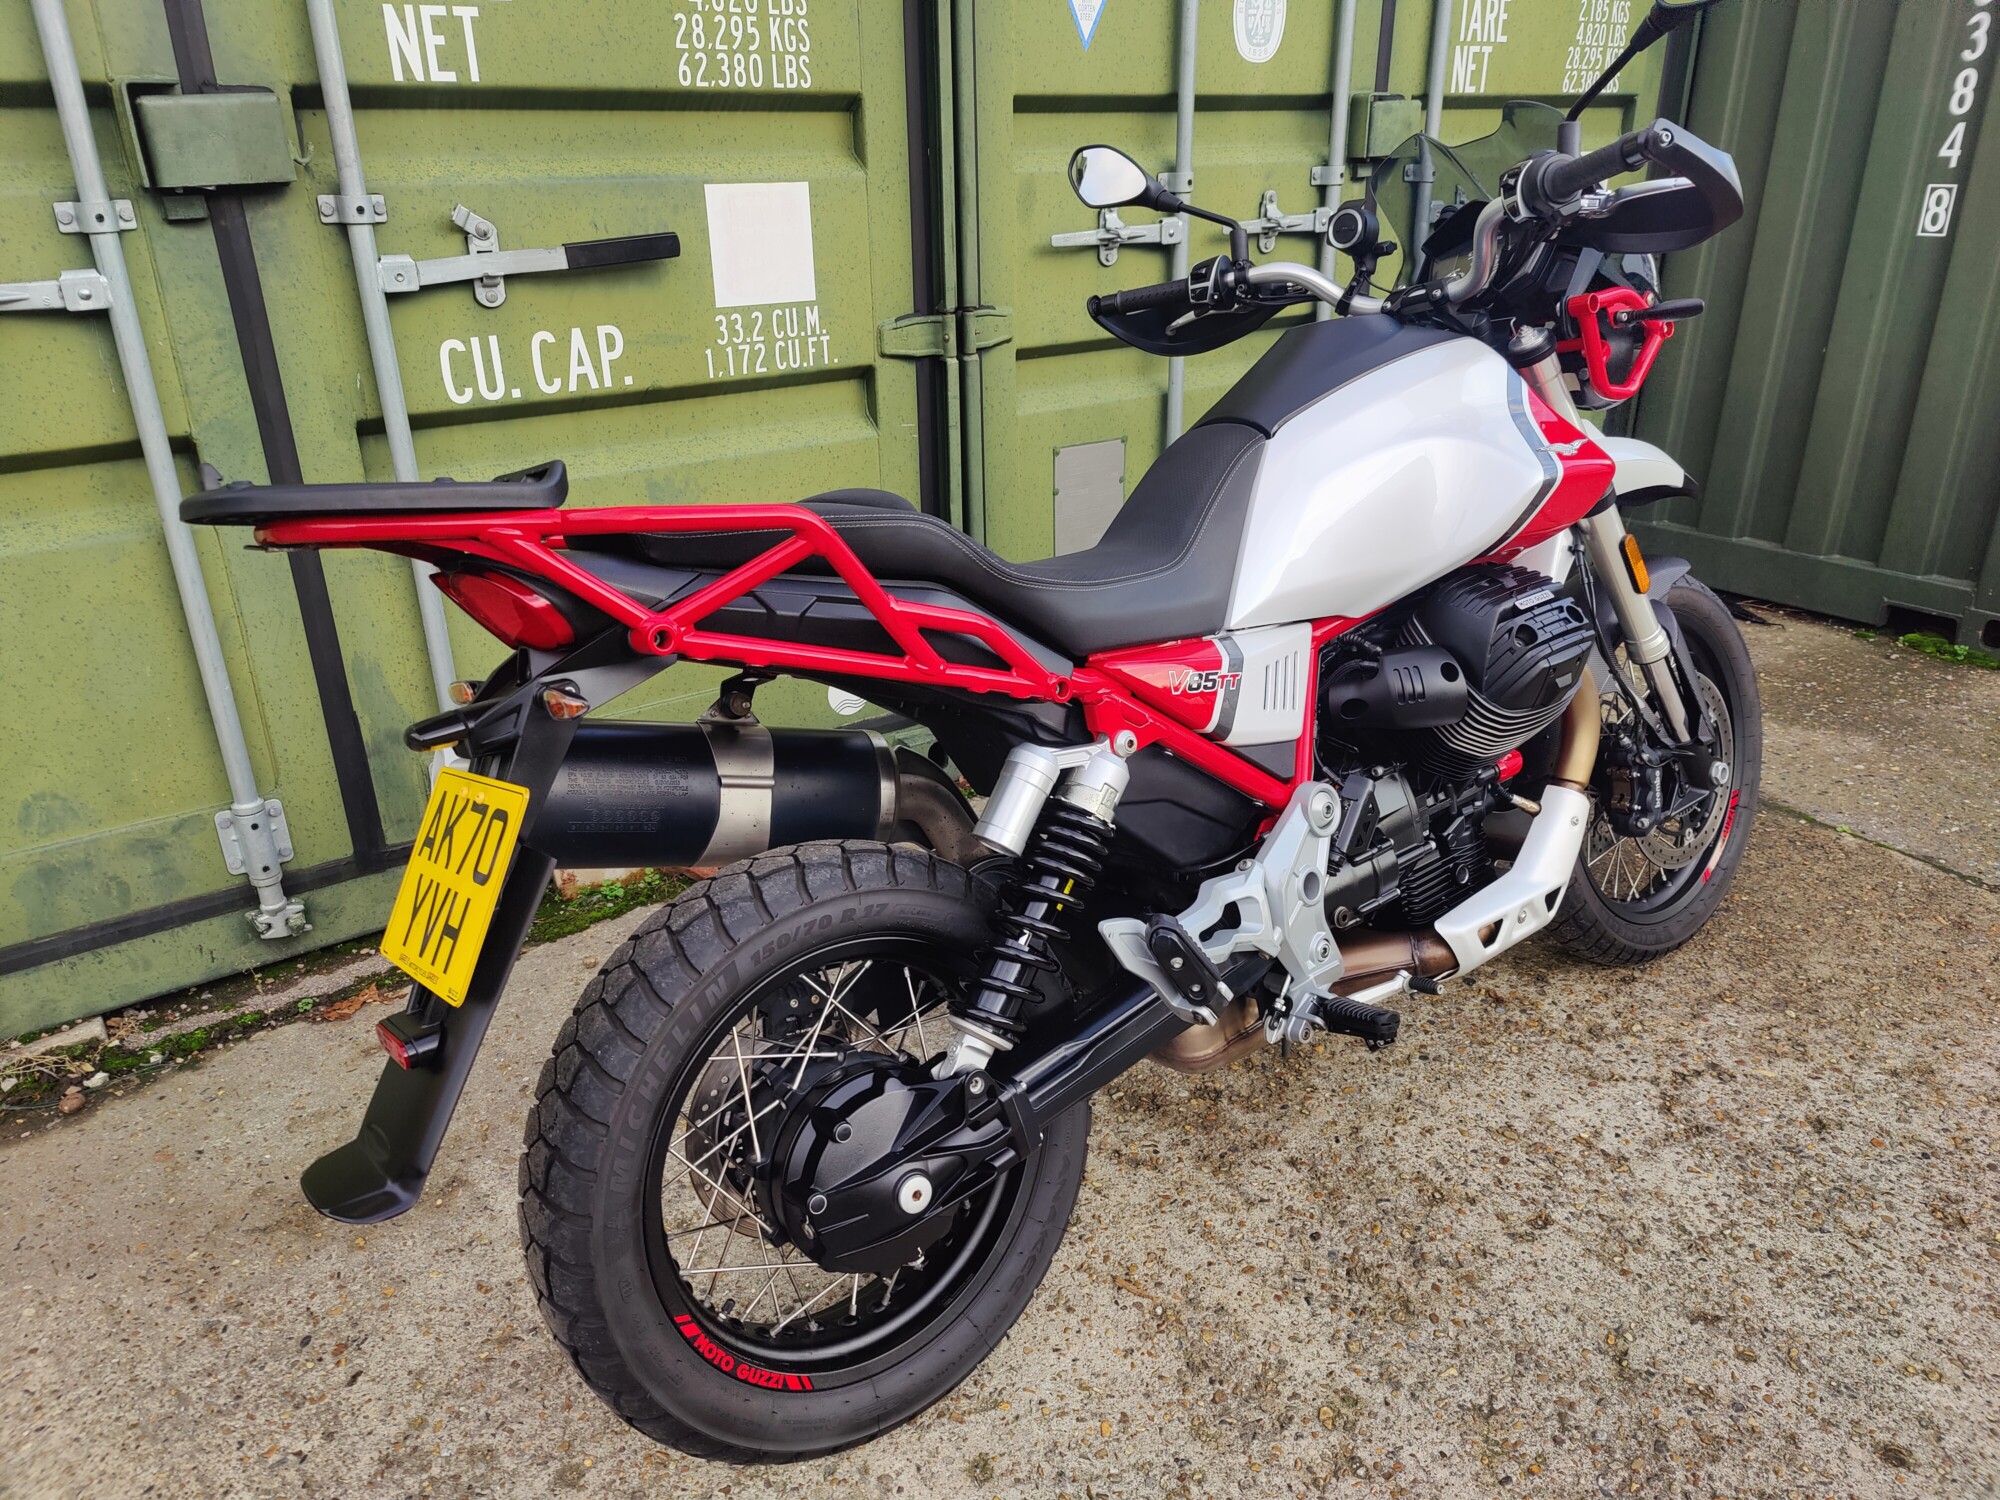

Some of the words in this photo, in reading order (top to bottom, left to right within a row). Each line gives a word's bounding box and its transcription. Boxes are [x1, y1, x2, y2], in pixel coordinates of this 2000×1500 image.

[673, 13, 760, 50] 28,295
[769, 16, 811, 52] KGS
[1460, 0, 1511, 42] TARE
[1611, 0, 1631, 23] KGS
[382, 3, 479, 82] NET
[1565, 46, 1603, 69] 28,295
[1608, 24, 1627, 47] LBS
[678, 52, 763, 88] 62,380
[772, 54, 812, 88] LBS
[1450, 45, 1493, 94] NET
[1921, 187, 1952, 233] 8
[715, 311, 765, 345] 33.2
[772, 305, 827, 339] CU.M.
[440, 335, 521, 404] CU.
[531, 325, 633, 394] CAP.
[705, 343, 767, 378] 1,172
[775, 335, 838, 370] CU.FT.
[1519, 598, 1535, 608] MOTO
[1534, 592, 1550, 601] GUZZI
[418, 790, 509, 886] AK70
[403, 873, 471, 974] YVH
[750, 914, 833, 967] 150/70
[840, 907, 857, 924] R
[862, 903, 889, 918] 17
[610, 973, 728, 1196] MICHELIN
[693, 1333, 735, 1372] MOTO
[737, 1363, 785, 1389] GUZZI
